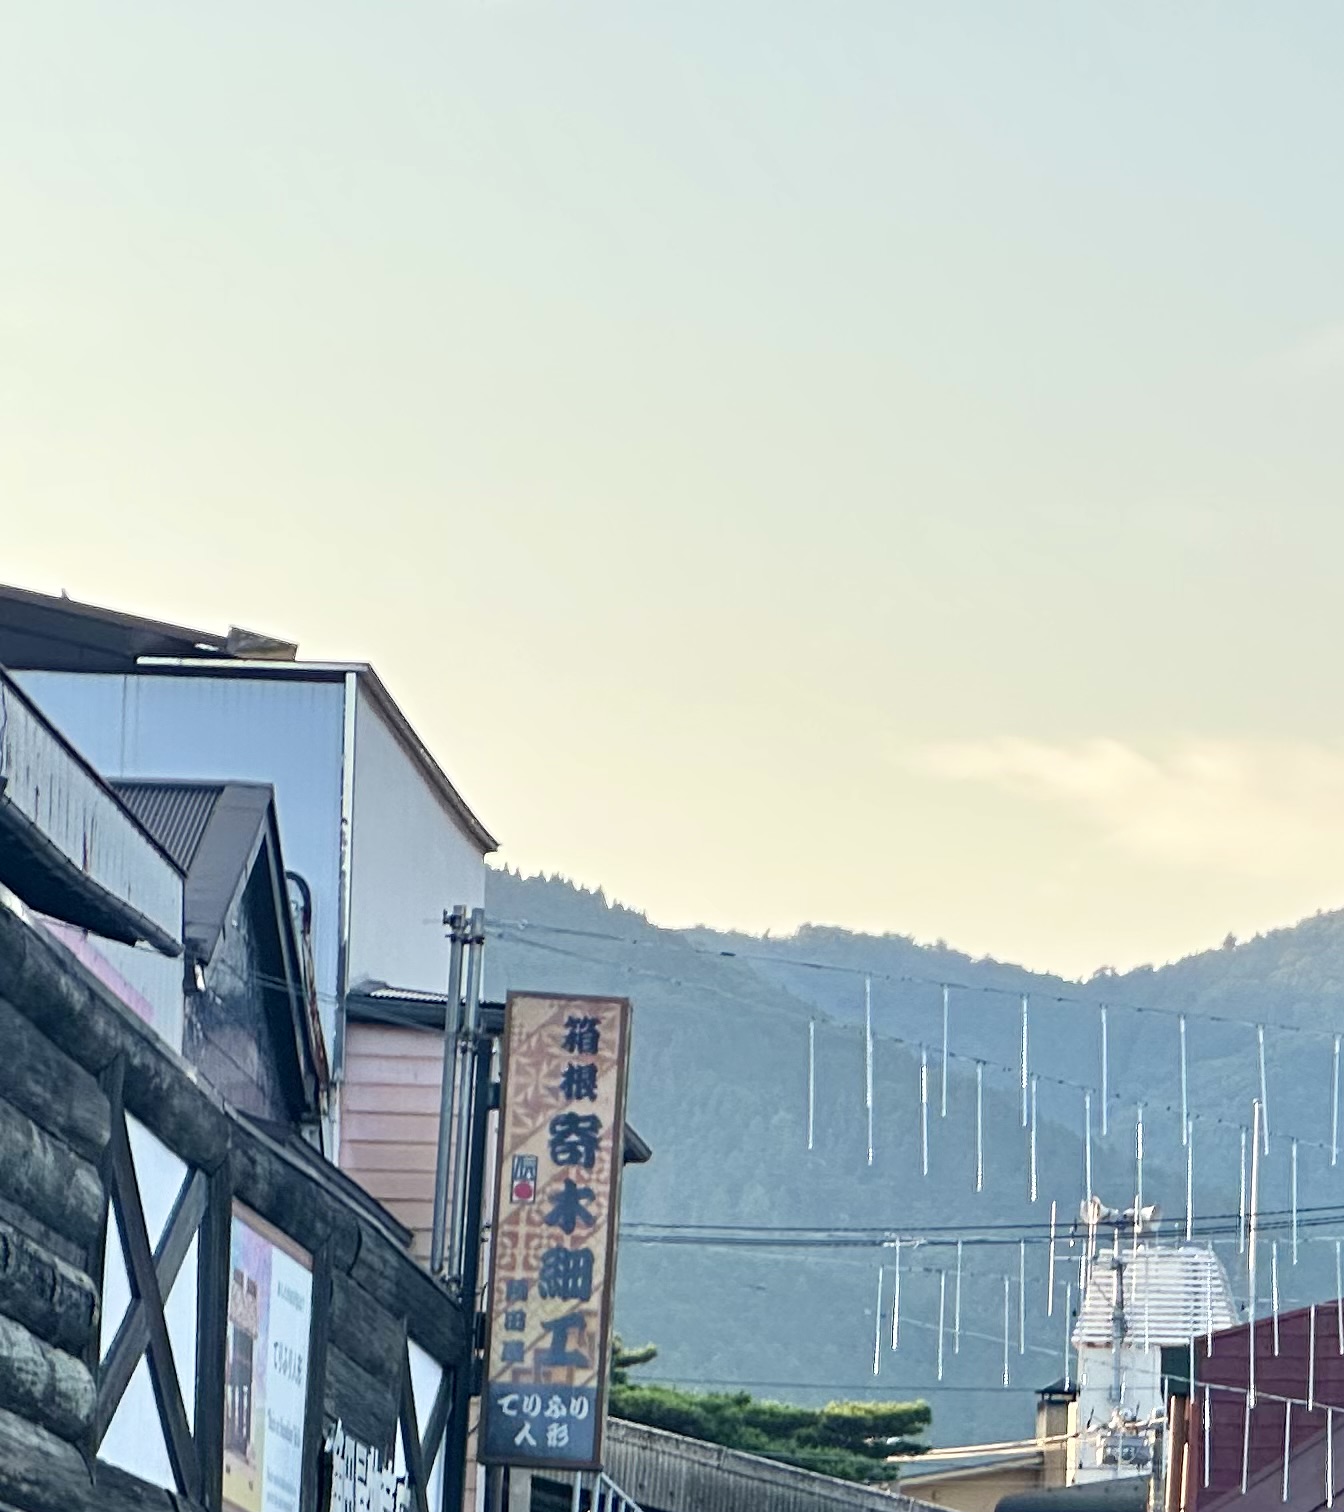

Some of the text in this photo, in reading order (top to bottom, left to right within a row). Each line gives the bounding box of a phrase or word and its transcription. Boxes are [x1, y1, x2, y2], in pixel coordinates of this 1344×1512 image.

[537, 1016, 601, 1368] 箱根寄木細工
[498, 1394, 589, 1418] てりふり
[514, 1422, 569, 1447] 人形
